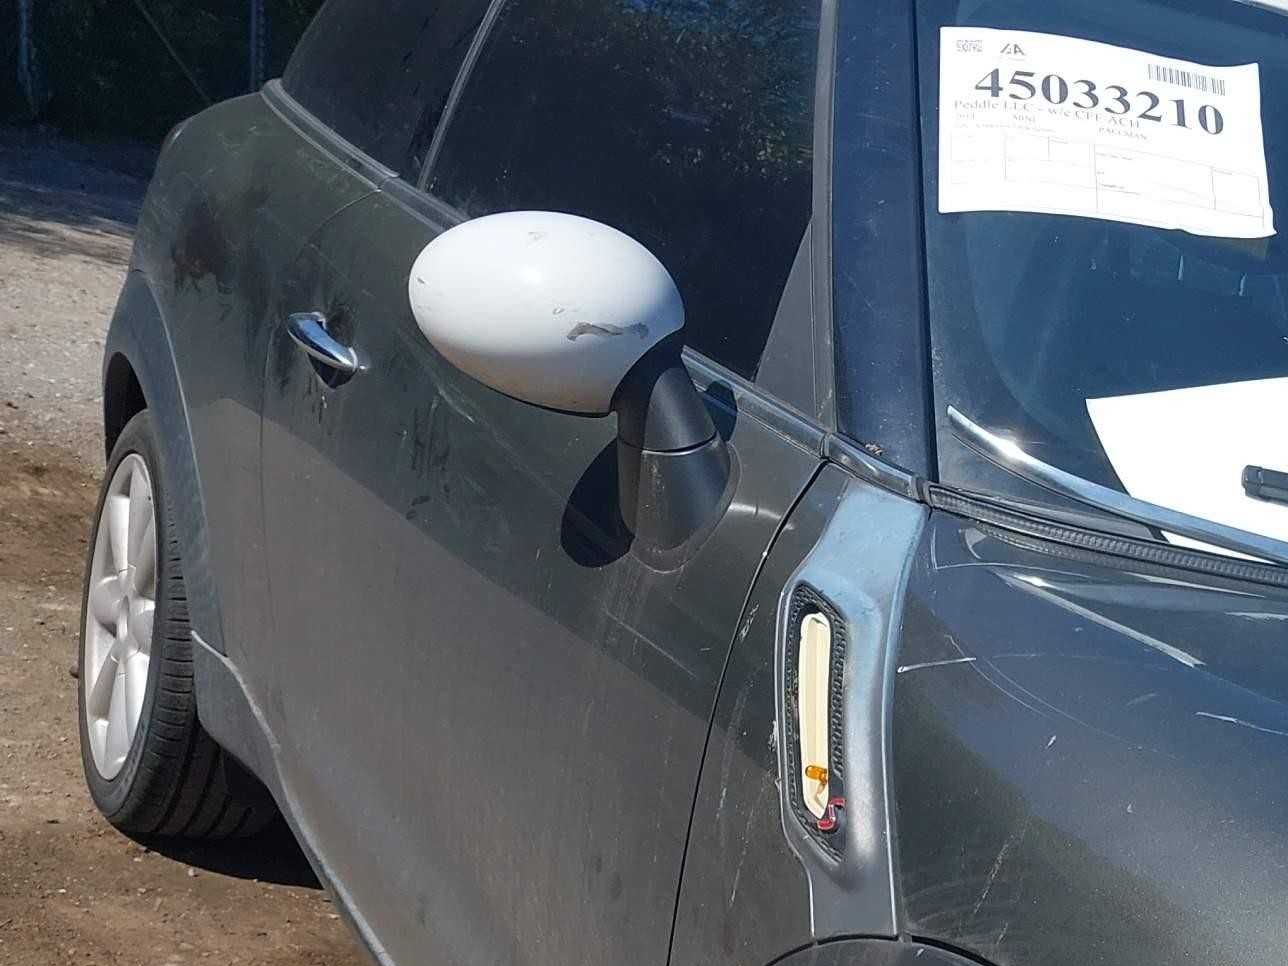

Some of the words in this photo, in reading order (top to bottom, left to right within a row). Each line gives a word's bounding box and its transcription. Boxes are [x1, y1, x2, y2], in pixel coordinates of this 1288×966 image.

[953, 99, 997, 110] Peddle
[1004, 99, 1034, 112] LLC
[974, 67, 1225, 136] 45033210
